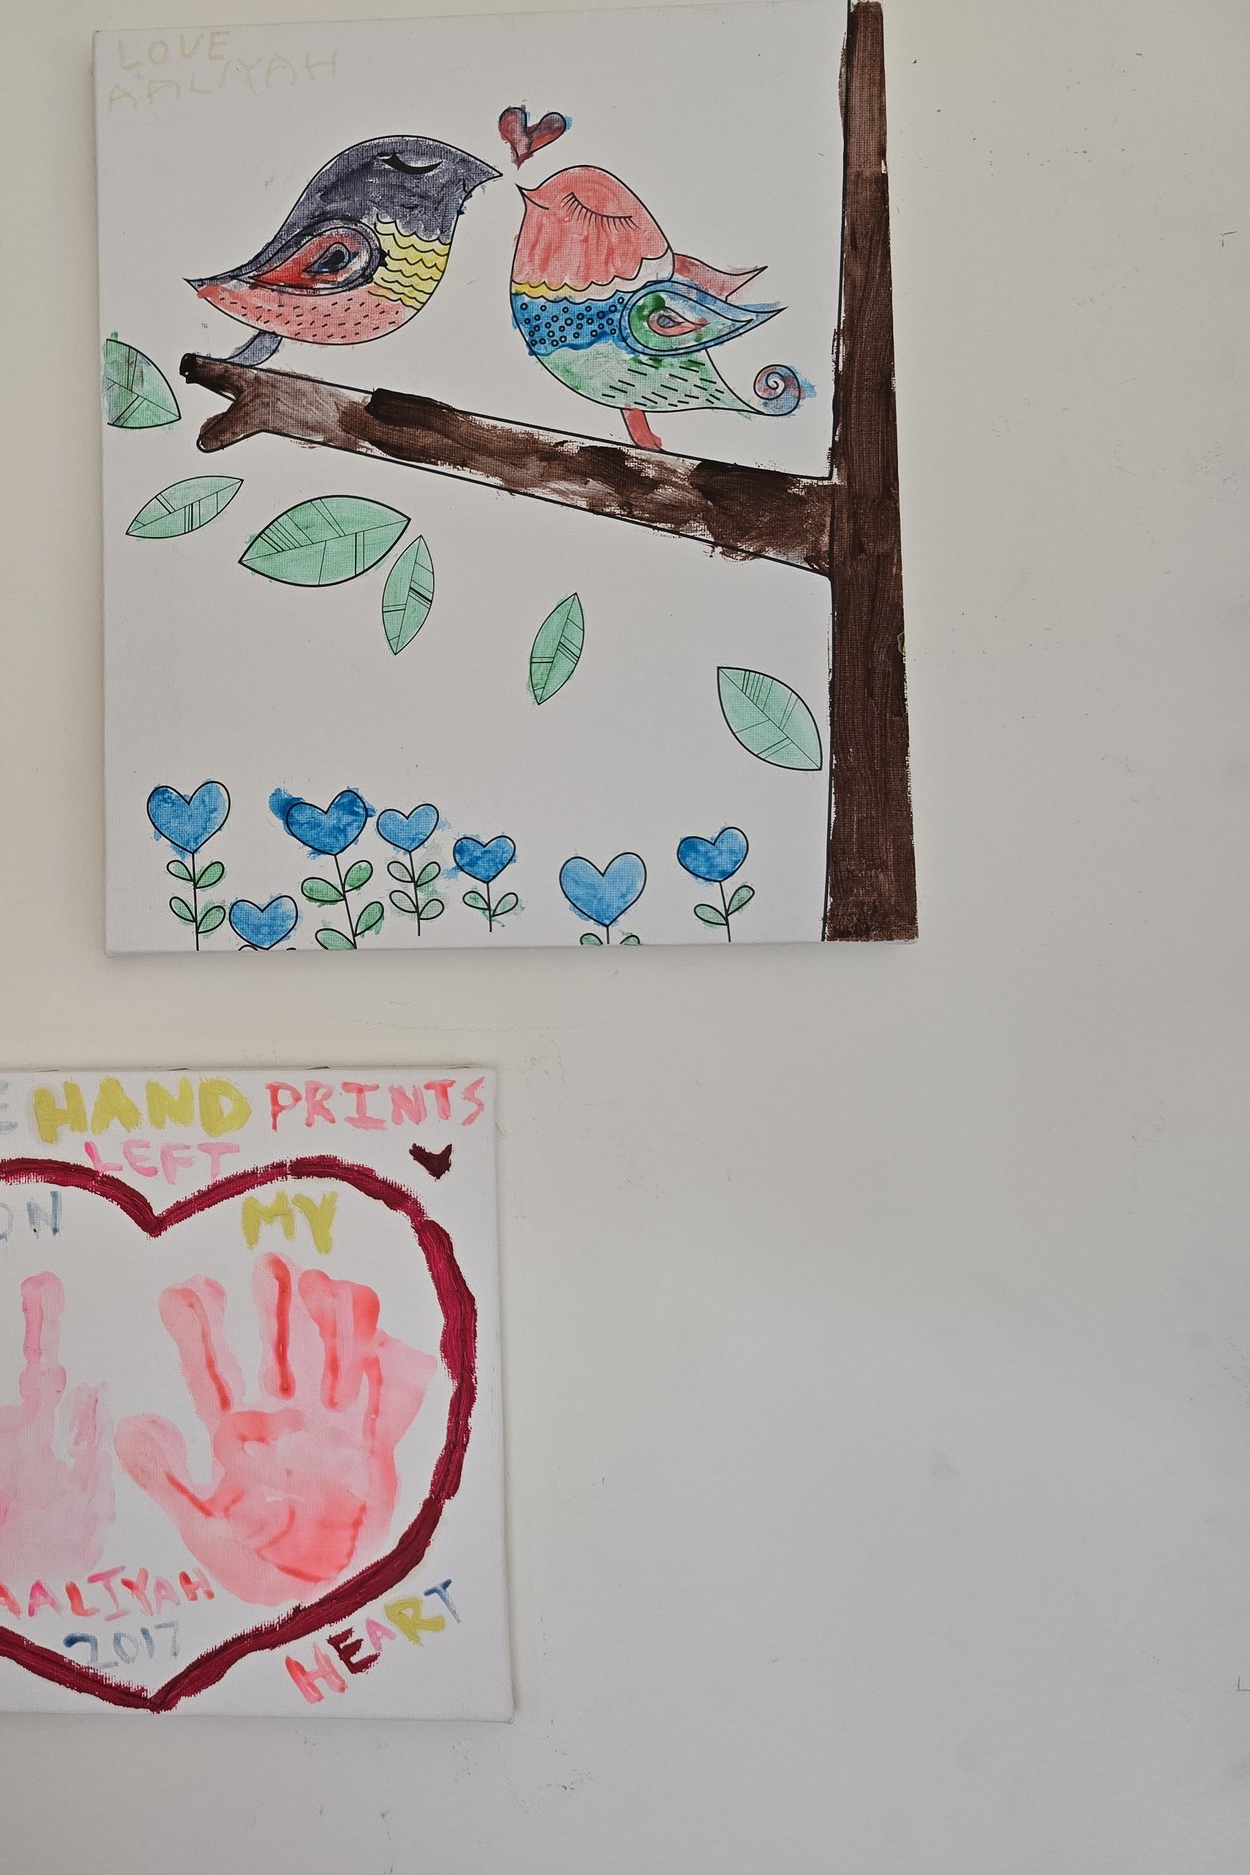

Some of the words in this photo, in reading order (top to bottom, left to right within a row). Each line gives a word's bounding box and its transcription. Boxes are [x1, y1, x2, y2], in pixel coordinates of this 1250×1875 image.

[118, 31, 230, 71] LOVE
[32, 1076, 252, 1143] HAND
[266, 1077, 486, 1132] PRINTS
[84, 1139, 241, 1185] LEFT
[242, 1190, 338, 1254] MY
[63, 1621, 182, 1670] 2017
[285, 1579, 462, 1704] HEART
